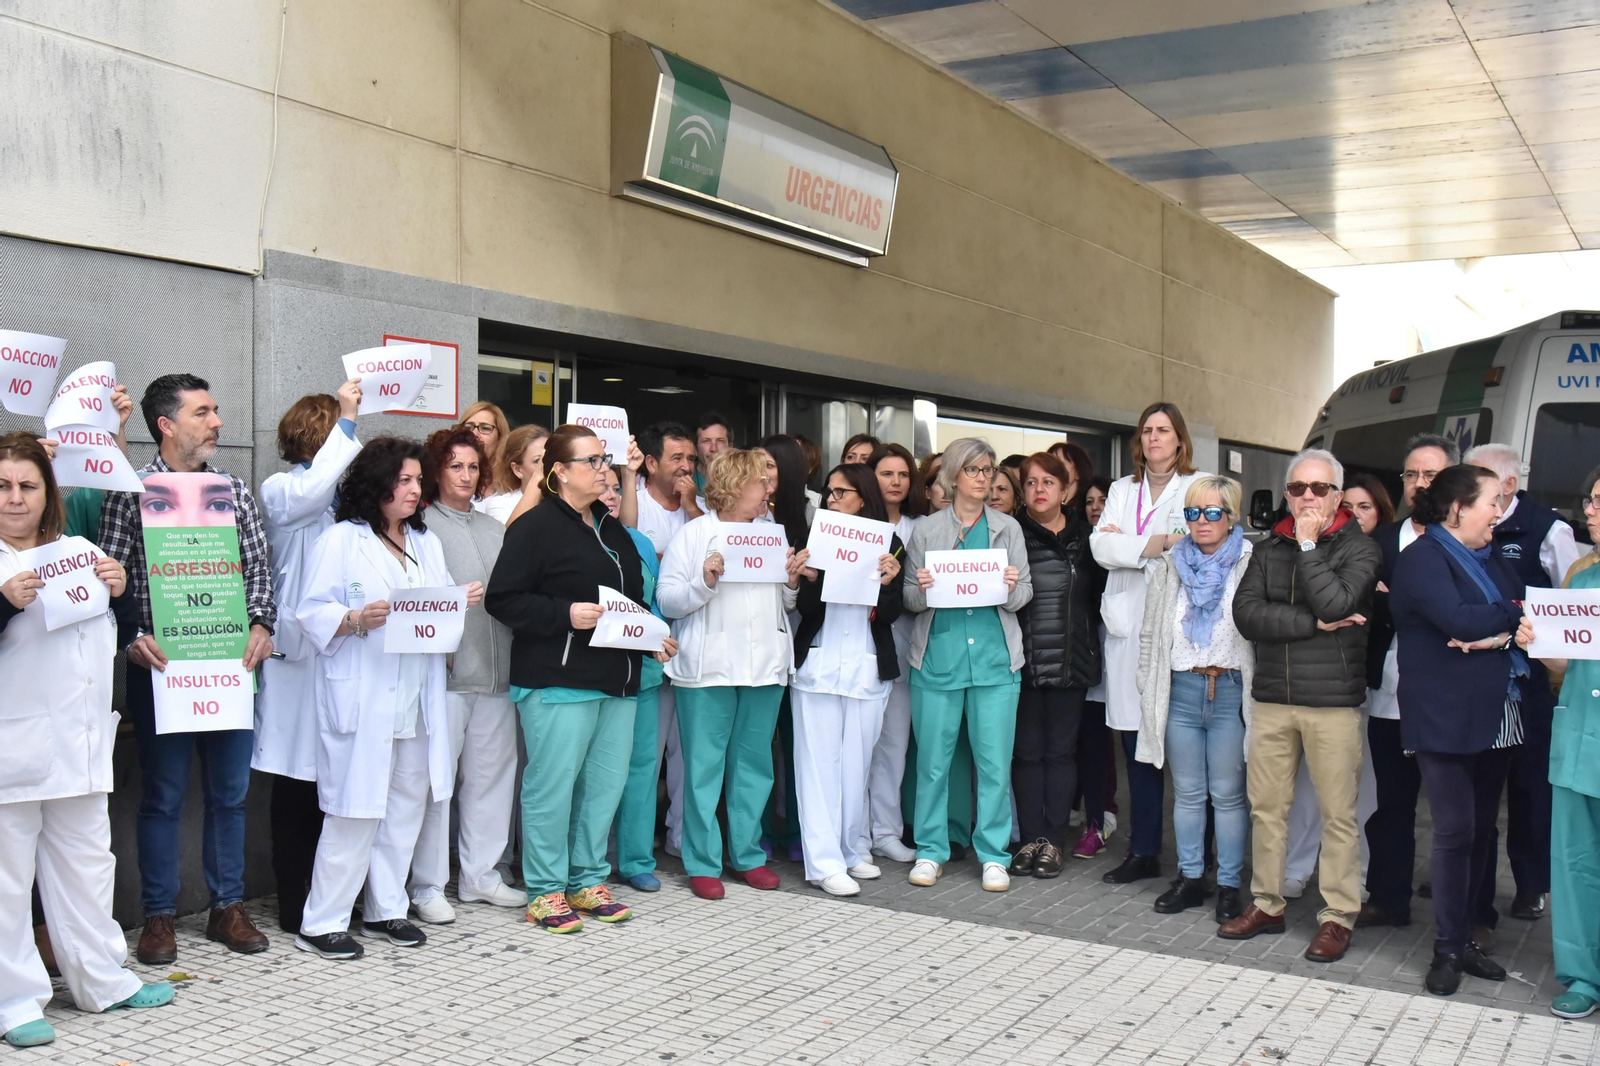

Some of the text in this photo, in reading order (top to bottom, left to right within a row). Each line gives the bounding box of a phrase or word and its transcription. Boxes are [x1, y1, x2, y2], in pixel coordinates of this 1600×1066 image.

[684, 159, 691, 170] DE
[785, 166, 882, 231] URGENCIAS
[1, 346, 58, 369] OACCION
[357, 359, 422, 374] COACCION
[9, 378, 32, 395] NO
[52, 374, 116, 404] IOLENCIA
[1340, 374, 1366, 397] UVI
[1558, 376, 1589, 388] UVI
[379, 383, 401, 396] NO
[79, 397, 102, 412] NO
[576, 417, 624, 429] COACCION
[84, 458, 113, 474] NO
[819, 521, 884, 545] VIOLENCIA
[727, 535, 782, 547] COACCION
[159, 548, 189, 556] atiendan
[836, 548, 858, 563] NO
[34, 550, 100, 581] VIOLENCIA
[149, 557, 243, 577] AGRESIÓN
[743, 556, 763, 569] NO
[933, 562, 1000, 574] VIOLENCIA
[65, 585, 89, 604] NO
[163, 592, 185, 600] toque,
[212, 590, 237, 598] puedan
[956, 583, 978, 595] NO
[187, 592, 213, 607] NO
[393, 600, 458, 612] VIOLENCIA
[178, 606, 226, 616] que compartir
[181, 615, 218, 623] habitación
[162, 627, 179, 637] ES
[182, 621, 244, 636] SOLUCIÓN
[414, 624, 435, 638] NO
[622, 624, 644, 638] NO
[167, 635, 180, 643] que
[1564, 629, 1592, 644] NO
[178, 641, 210, 650] personal,
[166, 674, 241, 688] INSULTOS
[192, 700, 220, 715] NO
